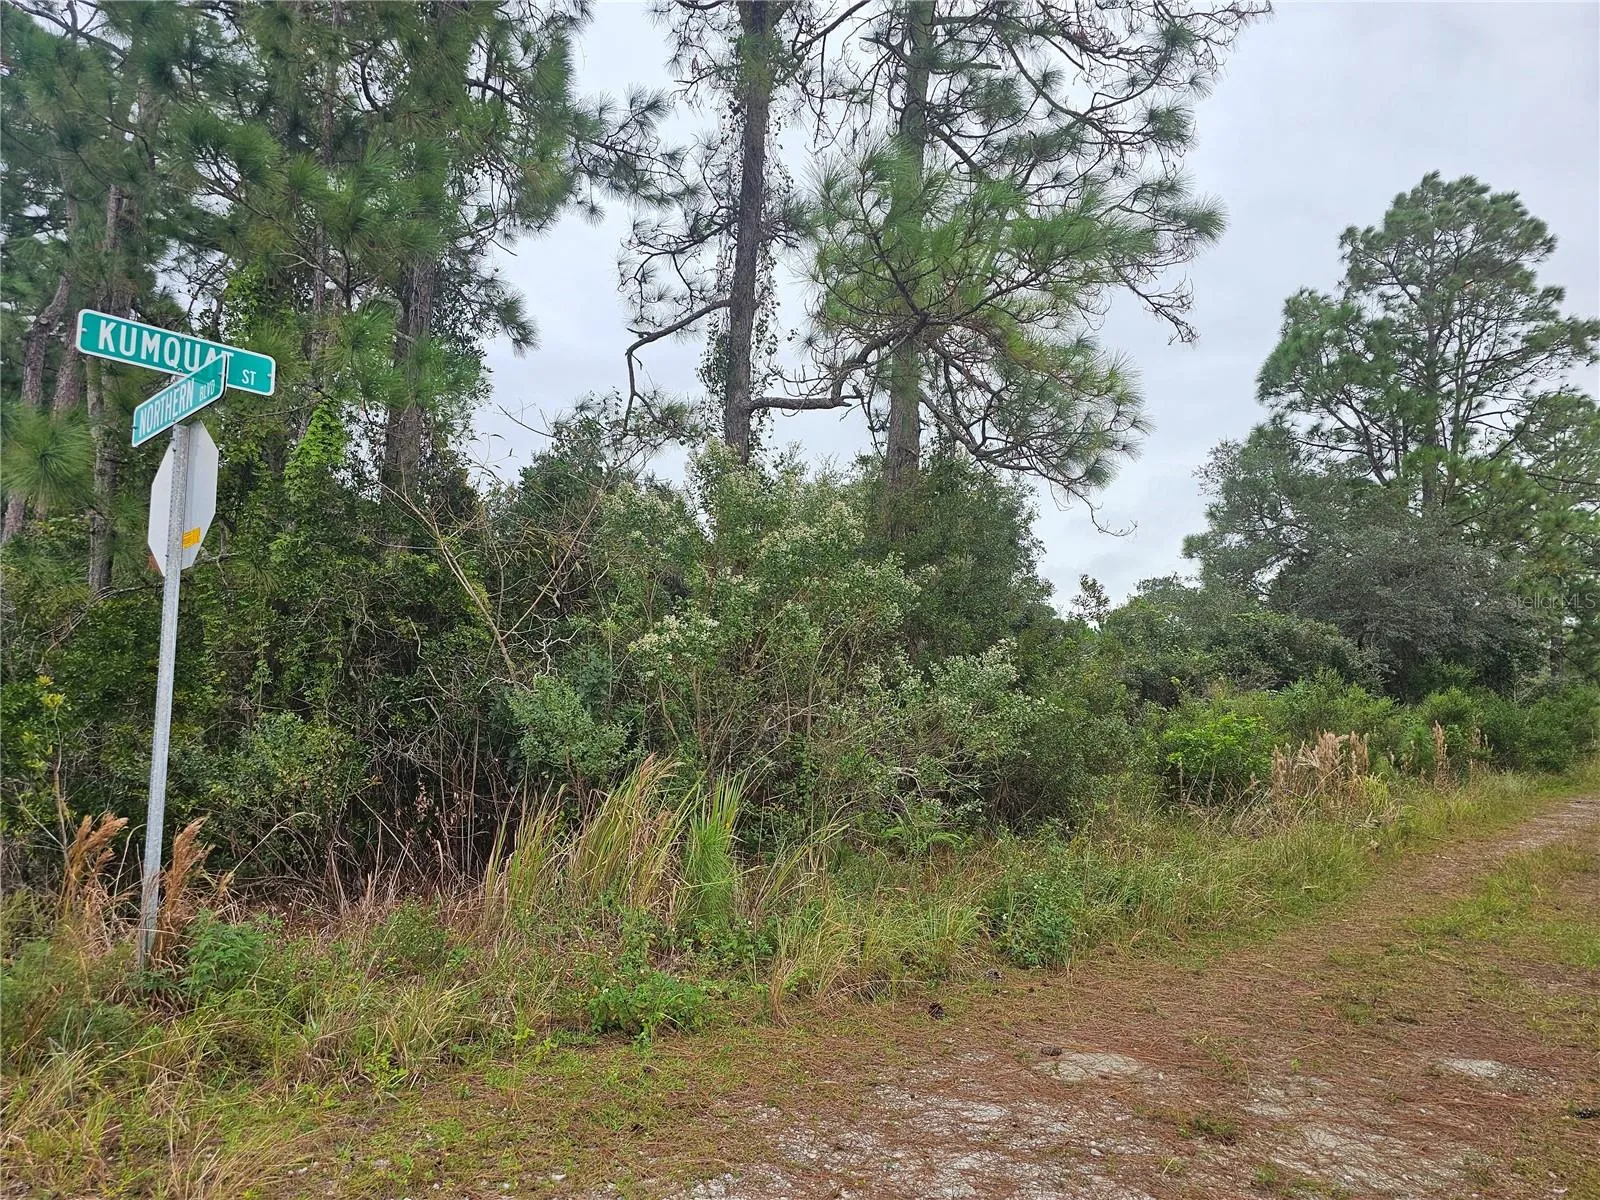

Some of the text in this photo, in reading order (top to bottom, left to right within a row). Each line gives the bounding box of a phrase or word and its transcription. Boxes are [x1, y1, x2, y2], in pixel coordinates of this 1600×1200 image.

[241, 369, 257, 386] ST
[139, 377, 216, 438] NORTHERN BLVD
